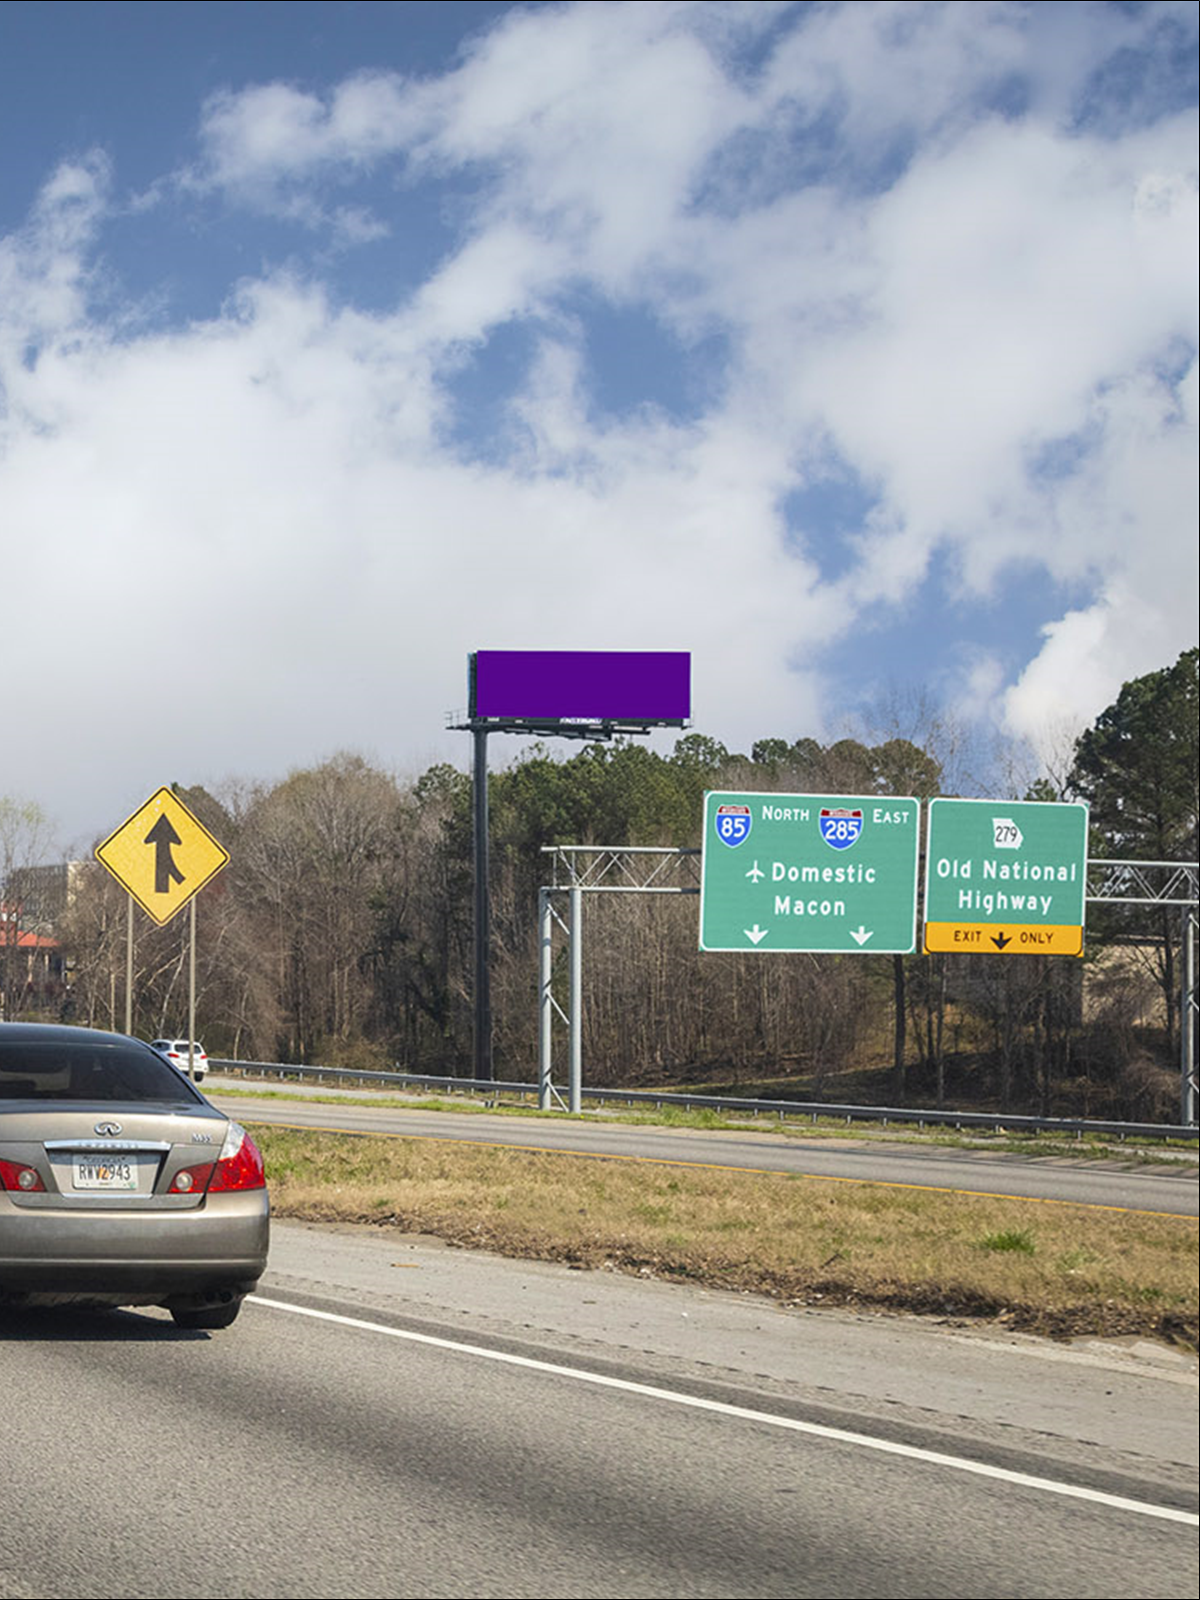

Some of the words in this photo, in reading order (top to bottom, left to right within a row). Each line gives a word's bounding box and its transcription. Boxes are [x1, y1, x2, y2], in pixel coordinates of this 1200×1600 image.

[762, 805, 810, 822] NORTH
[872, 808, 909, 824] EAST
[721, 817, 746, 838] 85
[825, 820, 859, 841] 285
[995, 826, 1018, 843] 279
[772, 861, 876, 884] Domestic
[937, 858, 972, 879] Old
[983, 859, 1076, 882] National
[774, 895, 846, 916] Macon
[958, 889, 1052, 916] Highway
[953, 930, 982, 942] EXIT
[1020, 931, 1054, 944] ONLY
